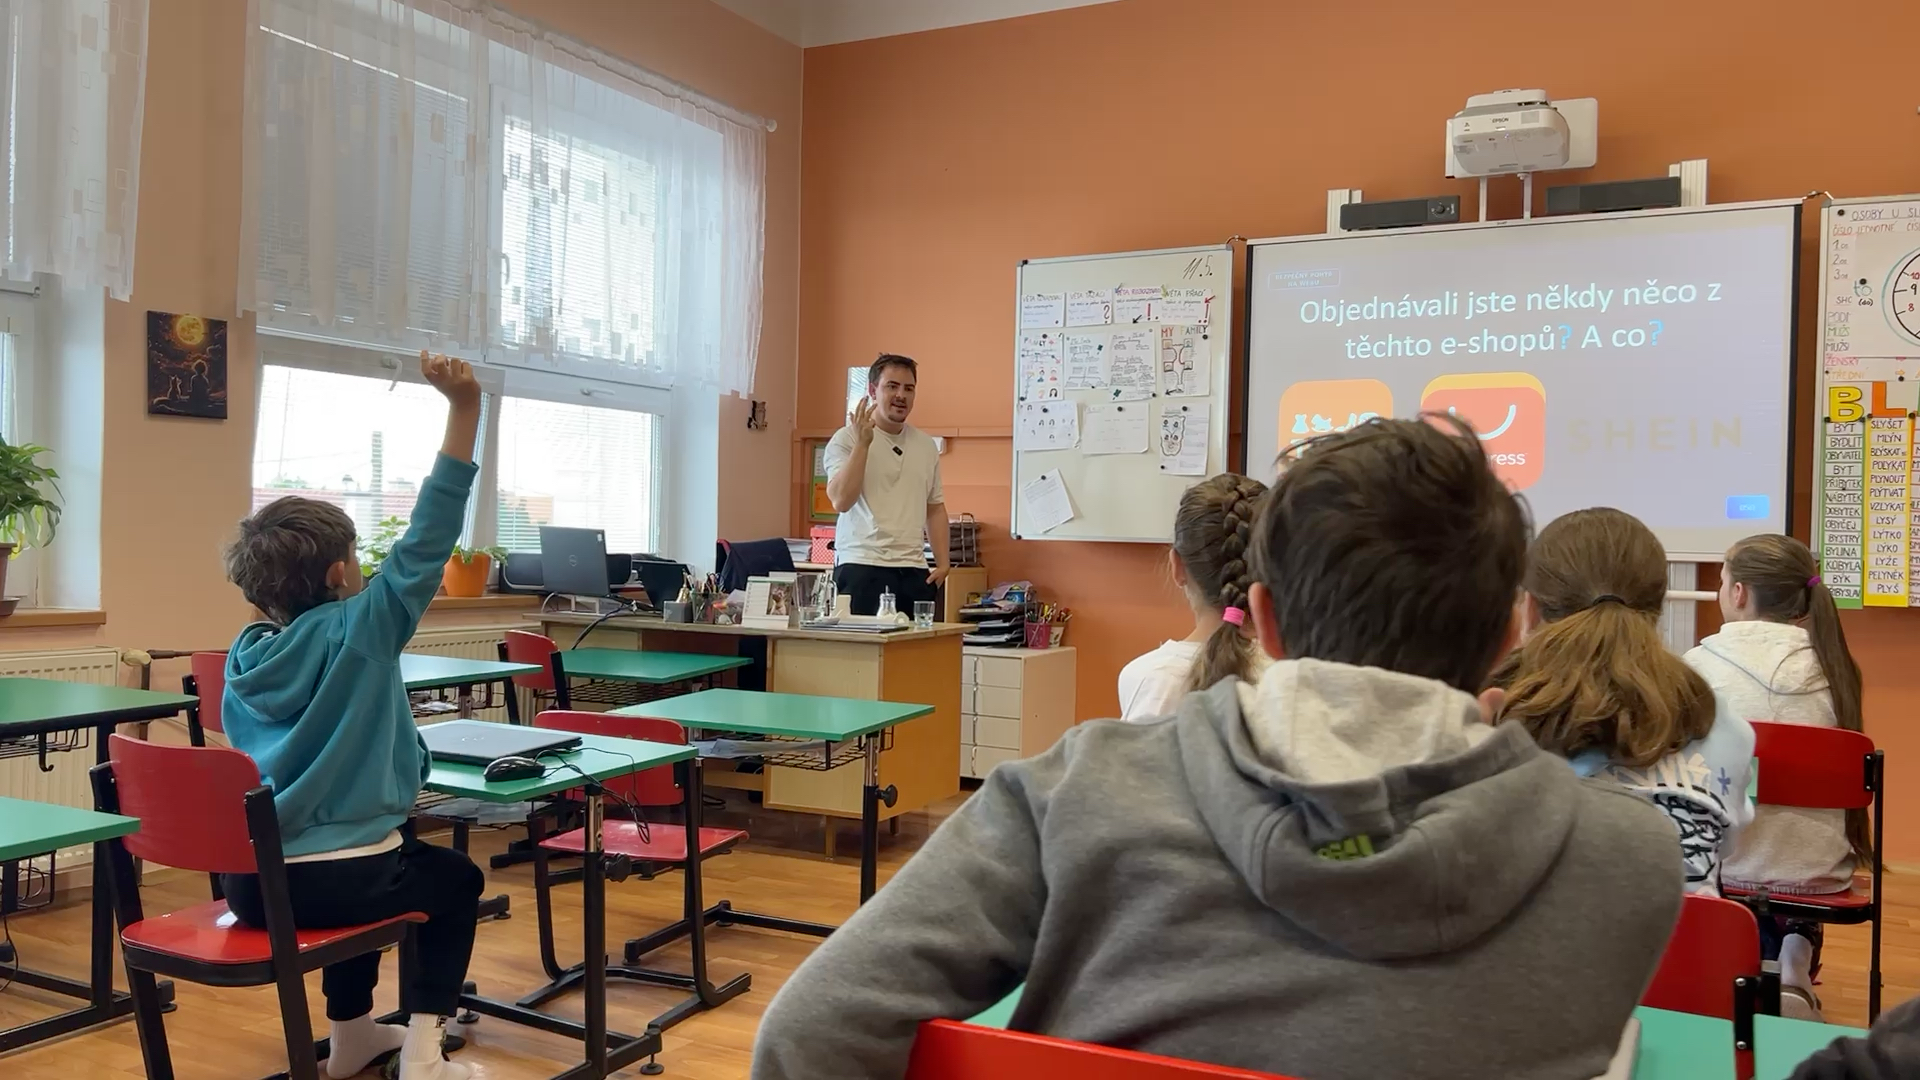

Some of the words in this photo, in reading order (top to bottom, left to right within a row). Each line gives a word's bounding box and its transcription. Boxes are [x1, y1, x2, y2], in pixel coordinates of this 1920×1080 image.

[1852, 209, 1884, 221] OSOBY
[1892, 209, 1899, 219] U
[1911, 283, 1917, 295] 9
[1300, 290, 1458, 327] Objednávali
[1465, 291, 1516, 320] jste
[1526, 282, 1614, 313] někdy
[1623, 279, 1697, 306] něco
[1707, 282, 1722, 301] z
[1908, 303, 1915, 312] 8
[1161, 327, 1174, 338] MY
[1181, 325, 1208, 335] FAMILY
[1345, 333, 1431, 359] těchto
[1440, 323, 1573, 357] e-shopů?
[1581, 324, 1603, 349] A
[1611, 319, 1664, 348] co?
[1829, 386, 1865, 423] B
[1872, 381, 1907, 418] L
[1871, 418, 1904, 429] SLYŠET
[1566, 414, 1742, 455] SHEIN
[1877, 432, 1902, 443] MLÝN
[1830, 436, 1863, 448] BYDLIT
[1826, 450, 1862, 460] OBYVATEL
[1870, 446, 1901, 457] BLÝSKAT
[1833, 465, 1854, 475] BYT
[1872, 460, 1907, 471] POLYKAT
[1870, 474, 1906, 484] PLYNOUT
[1825, 491, 1862, 503] NÁBYTEK
[1870, 486, 1906, 498] PLÝTVAT
[1826, 506, 1860, 516] DOBYTEK
[1870, 502, 1906, 512] VZLYKAT
[1826, 519, 1857, 530] OBYČEJ
[1876, 514, 1896, 525] LYSÝ
[1873, 528, 1902, 540] LÝTKO
[1826, 546, 1857, 557] BYLINA
[1876, 542, 1898, 553] LÝKO
[1826, 560, 1861, 571] KOBYLA
[1875, 555, 1898, 567] LYŽE
[1877, 583, 1899, 594] PLYŠ
